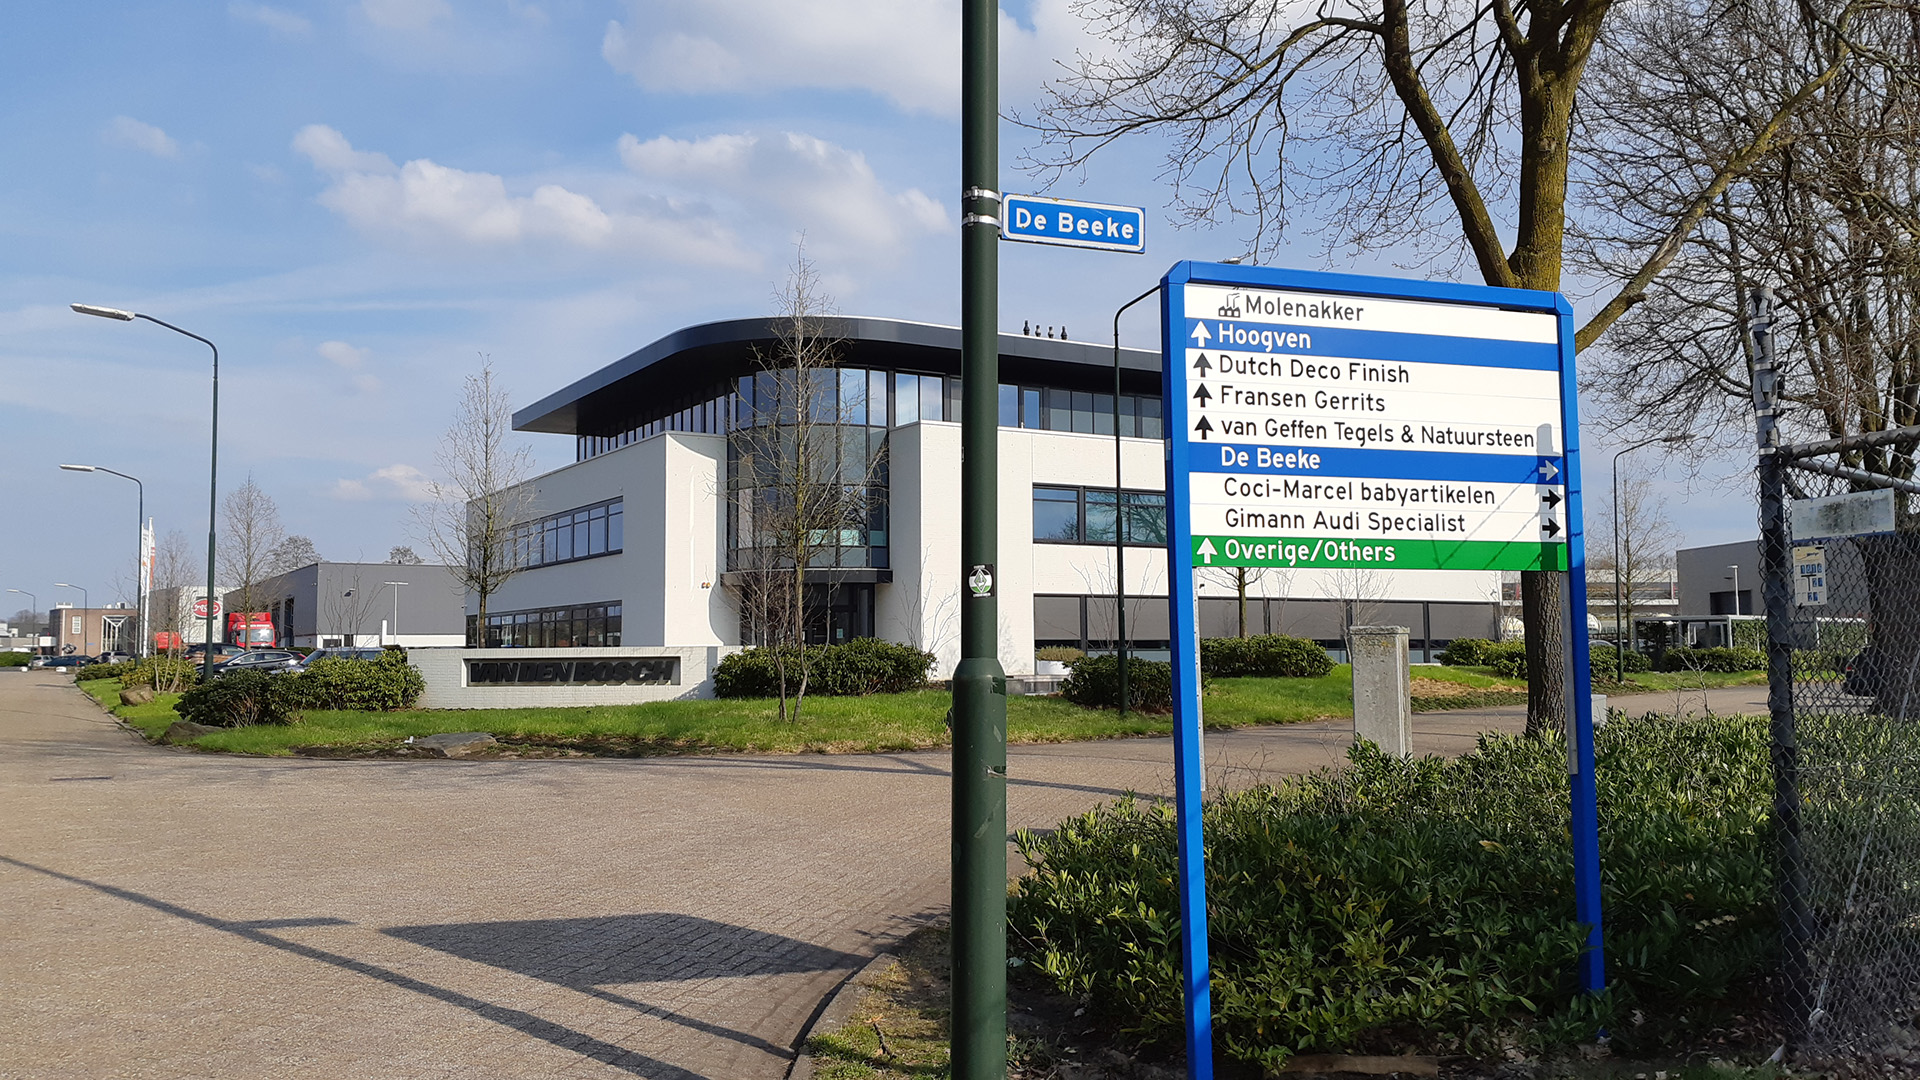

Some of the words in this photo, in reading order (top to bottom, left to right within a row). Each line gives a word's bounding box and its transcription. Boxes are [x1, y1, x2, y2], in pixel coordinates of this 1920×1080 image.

[1016, 207, 1047, 230] De
[1058, 212, 1135, 239] Beeke
[1246, 294, 1364, 321] Molenakker
[1218, 322, 1312, 353] Hoogven
[1219, 354, 1282, 376] Dutch
[1290, 359, 1341, 380] Deco
[1349, 362, 1410, 383] Finish
[1221, 385, 1306, 408] Fransen
[1315, 390, 1386, 412] Gerrits
[1221, 420, 1257, 436] van
[1265, 418, 1327, 440] Geffen
[1334, 421, 1394, 447] Tegels
[1401, 424, 1415, 444] &
[1421, 425, 1534, 448] Natuursteen
[1221, 446, 1249, 467] De
[1257, 447, 1321, 469] Beeke
[1224, 477, 1352, 500] Coci-Marcel
[1361, 481, 1495, 507] babyartikelen
[1225, 508, 1305, 530] Gimann
[1313, 510, 1360, 531] Audi
[1368, 512, 1466, 535] Specialist
[1225, 538, 1396, 567] Overige/Others
[470, 662, 519, 682] VAN
[517, 661, 574, 682] DEN
[573, 660, 675, 682] BOSCH
